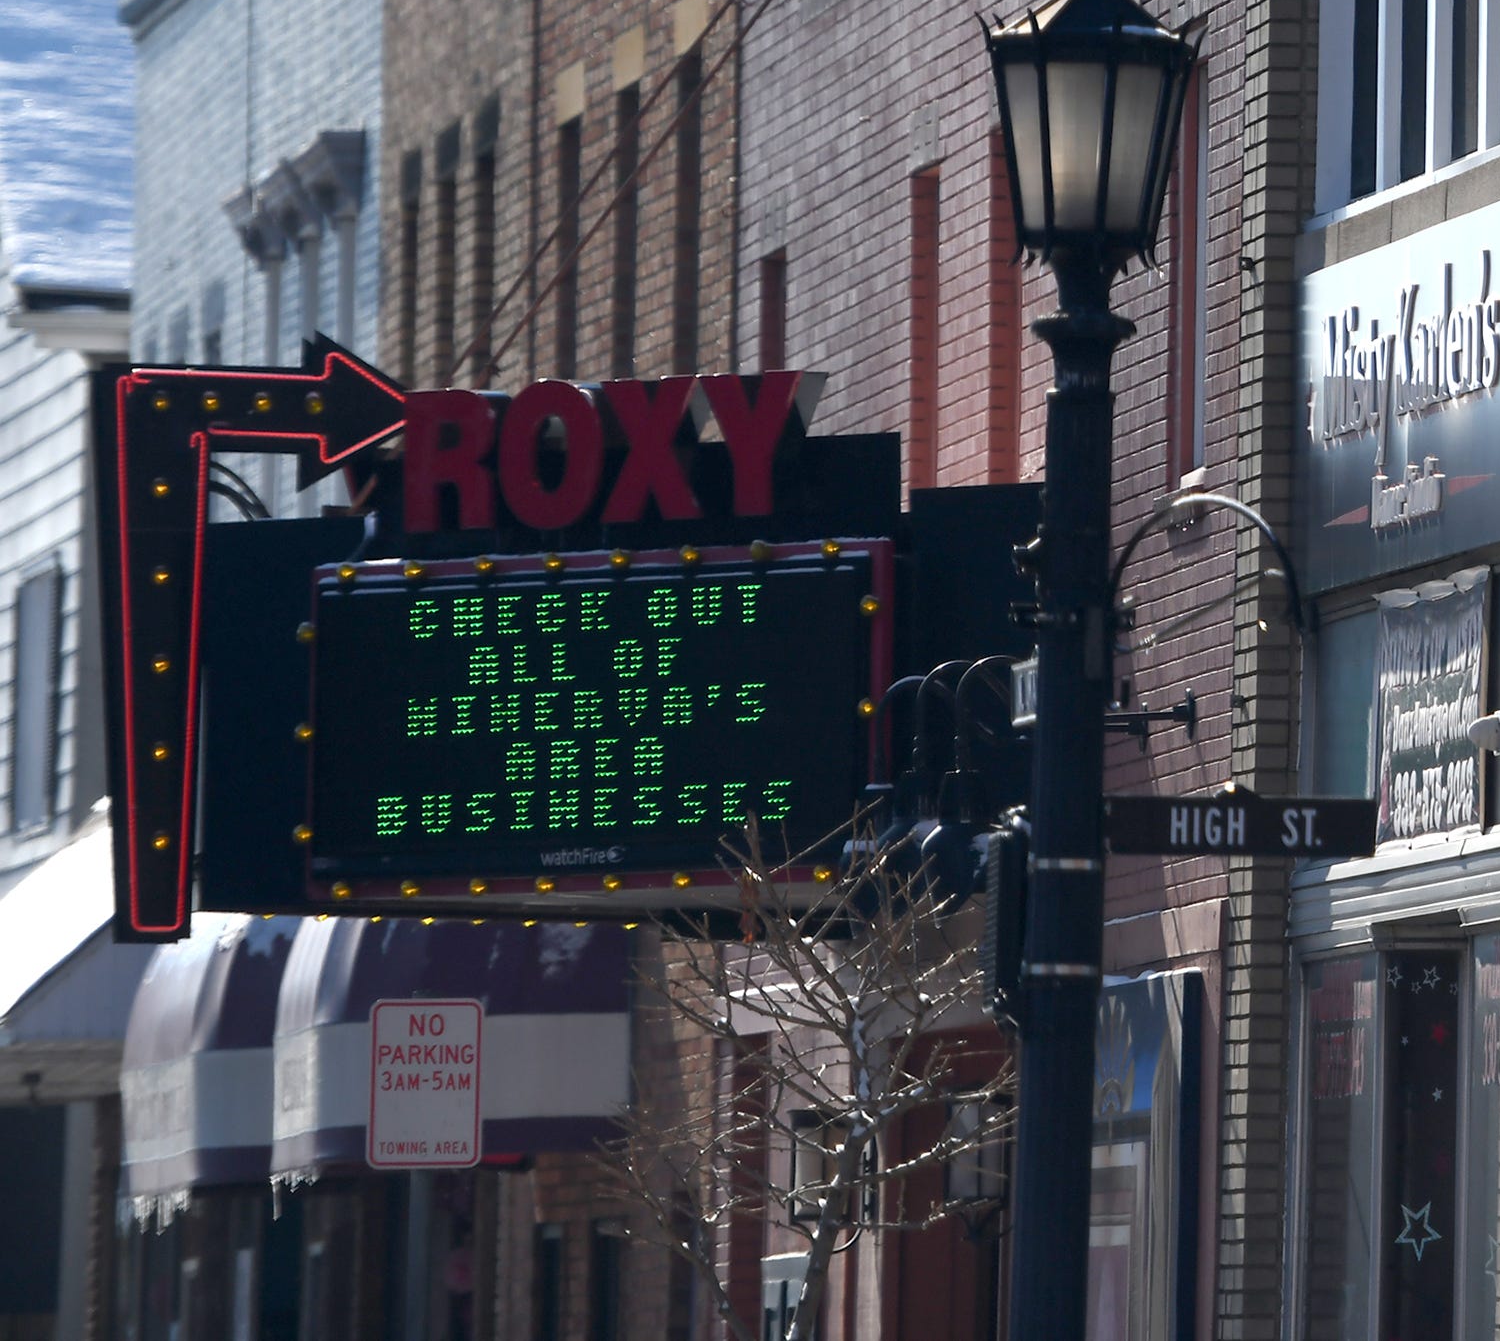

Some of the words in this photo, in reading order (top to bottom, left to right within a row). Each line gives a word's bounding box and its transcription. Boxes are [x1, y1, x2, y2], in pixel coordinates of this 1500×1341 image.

[1322, 305, 1397, 467] Misty
[404, 371, 806, 534] ROXY
[409, 590, 611, 639] CHECK
[647, 584, 764, 625] OUT
[469, 642, 577, 686] ALL
[613, 636, 684, 678] OF
[407, 682, 767, 737] MINERVA'S
[506, 736, 664, 781] AREA
[377, 780, 792, 835] BUSINESSES
[1170, 806, 1245, 847] HIGH
[1281, 807, 1322, 847] ST.
[409, 1013, 445, 1037] NO
[377, 1043, 475, 1065] PARKING
[381, 1070, 471, 1091] 3AM-5AM
[379, 1140, 427, 1156] TOWING
[434, 1140, 469, 1155] AREA
